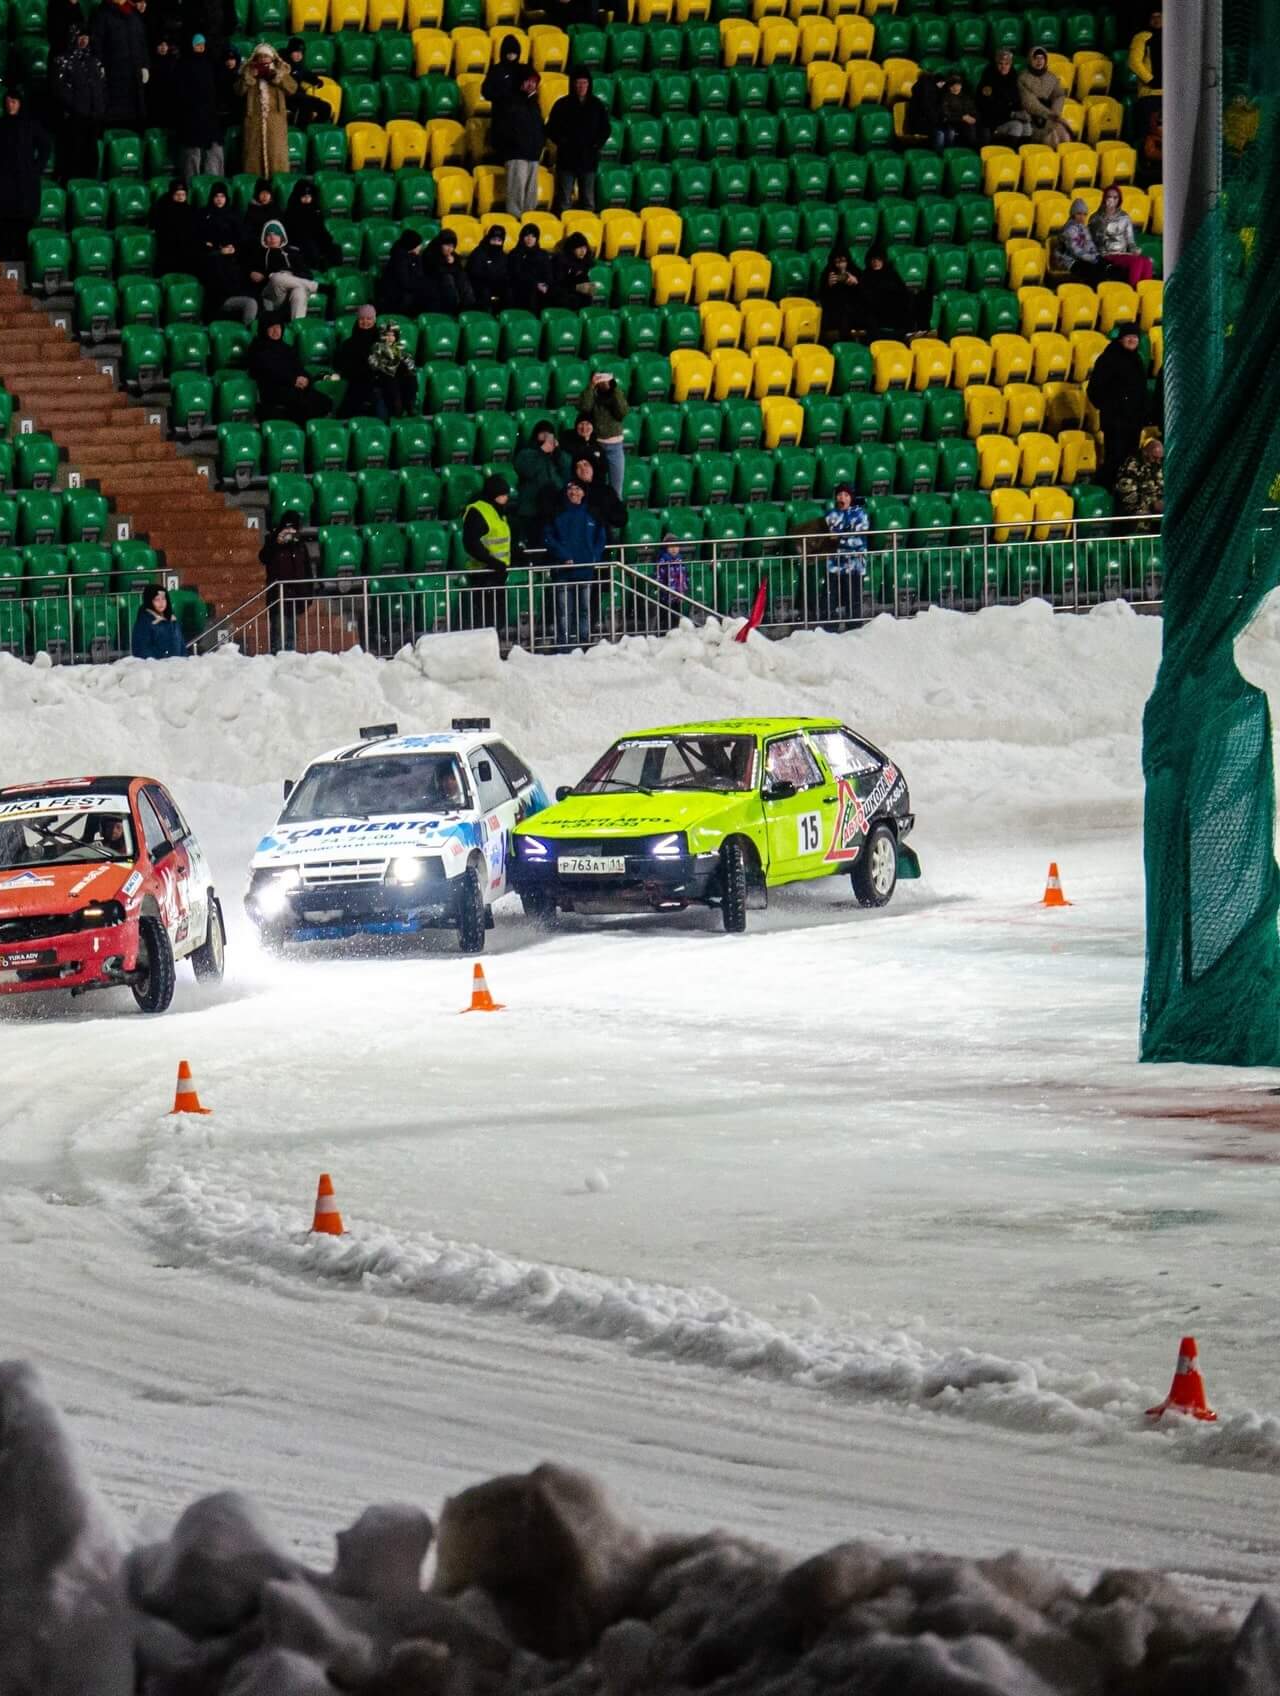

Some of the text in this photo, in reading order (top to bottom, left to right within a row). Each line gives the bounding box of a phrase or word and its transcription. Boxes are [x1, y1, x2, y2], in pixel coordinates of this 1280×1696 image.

[49, 797, 113, 808] FEST
[287, 820, 440, 840] CARVENTA
[801, 814, 820, 851] 15
